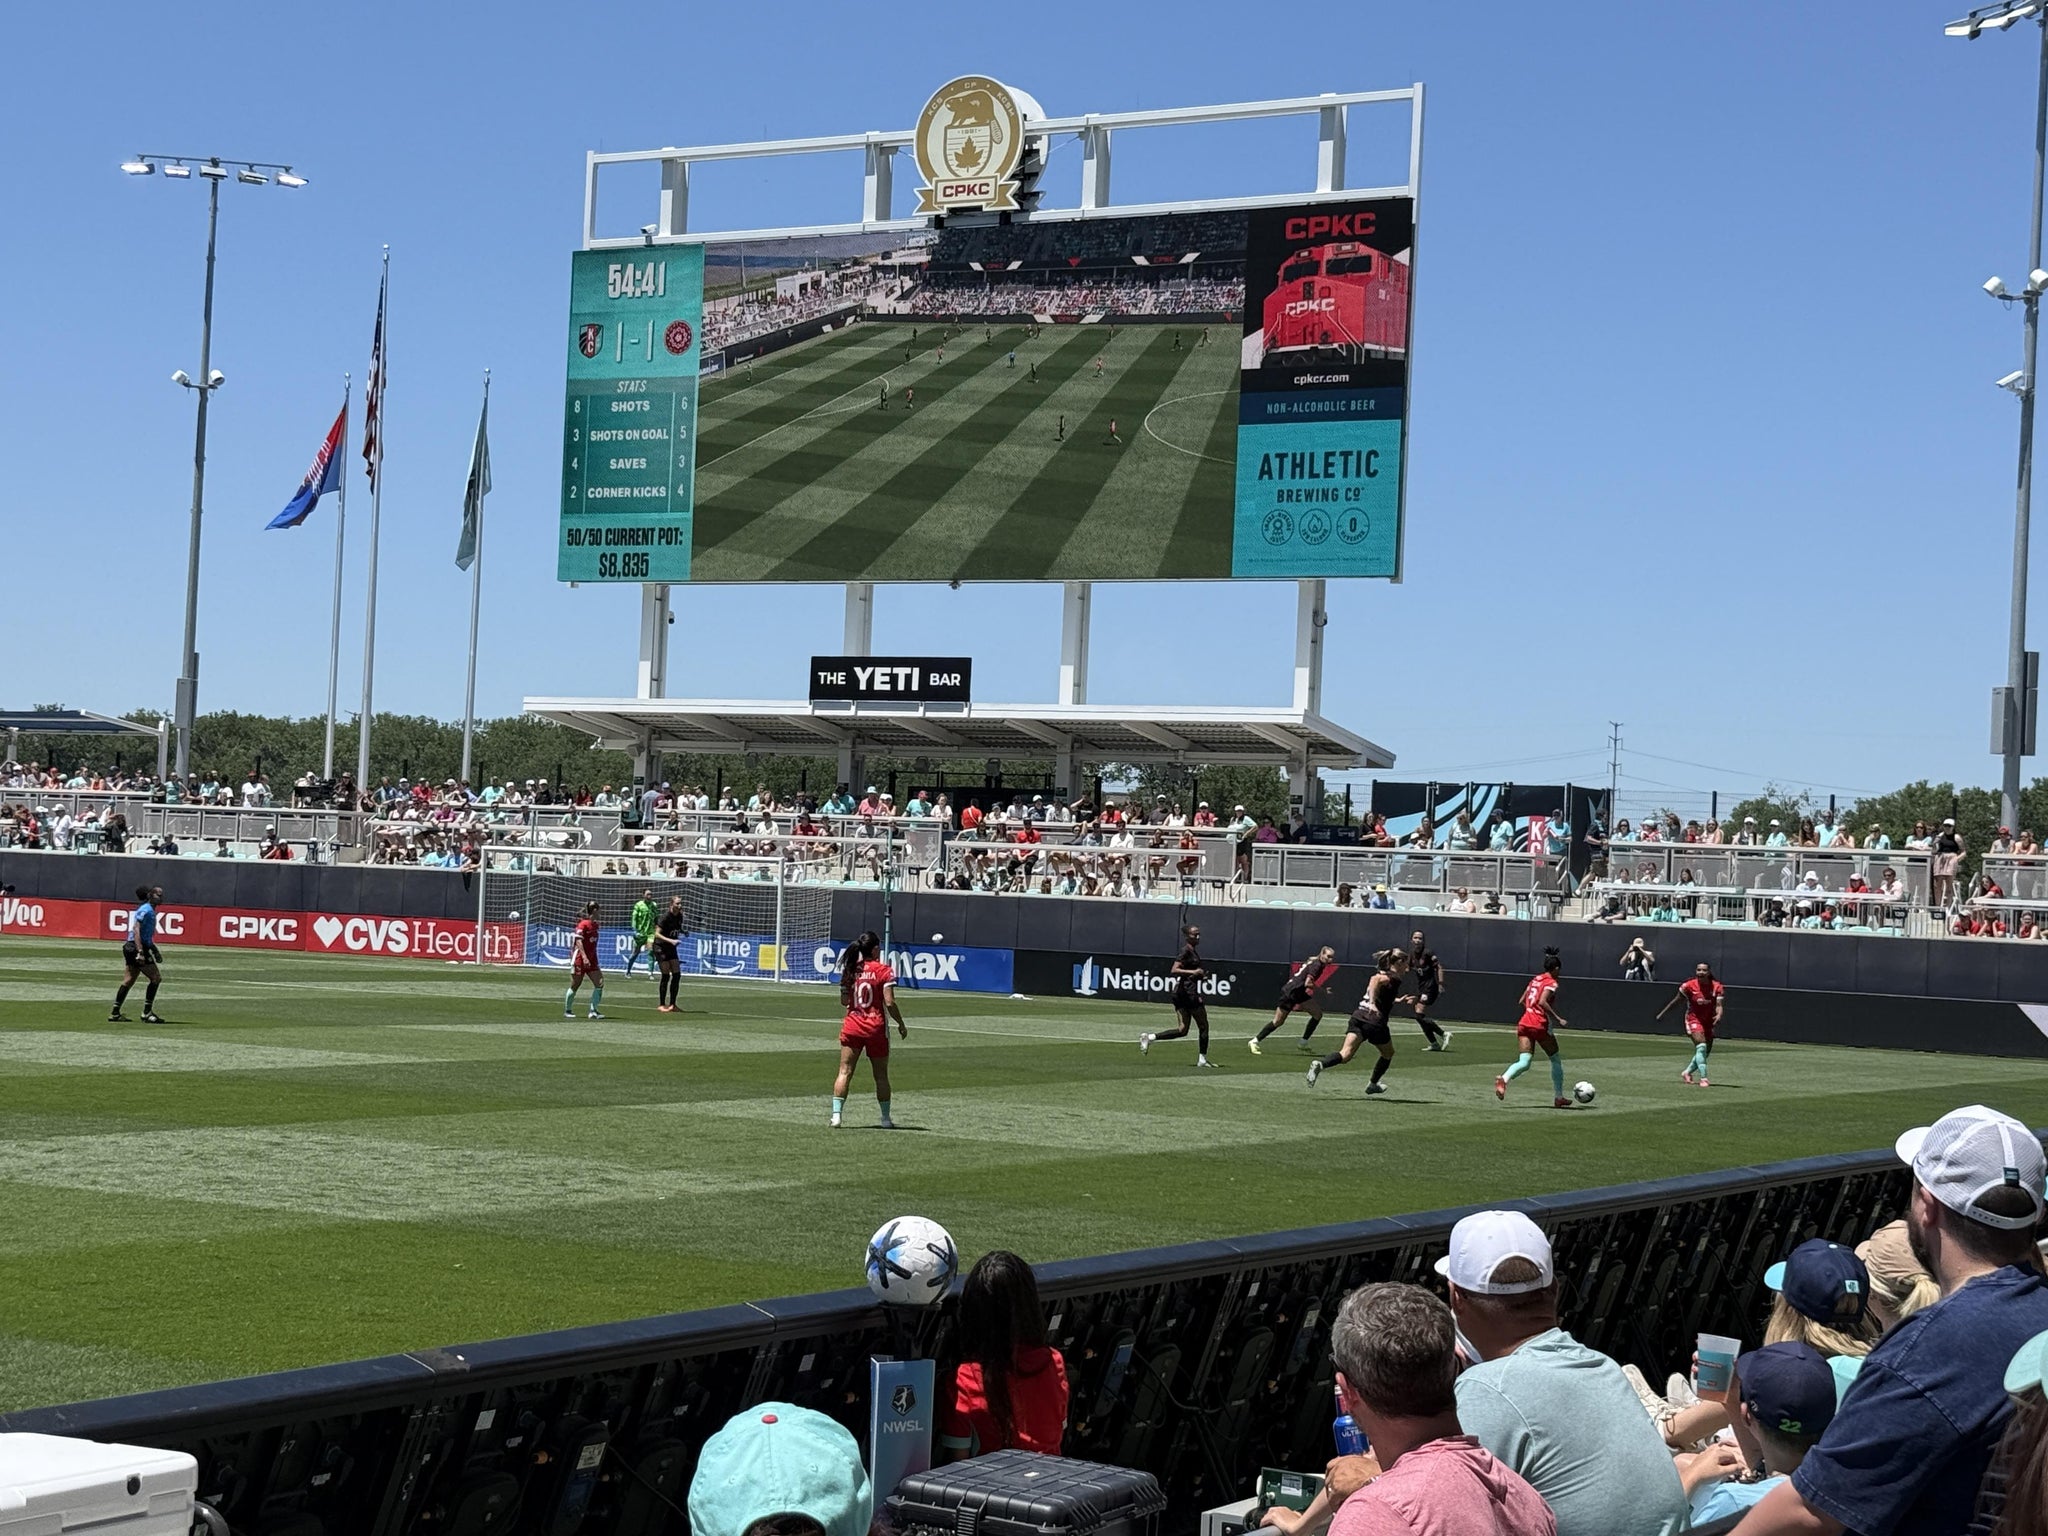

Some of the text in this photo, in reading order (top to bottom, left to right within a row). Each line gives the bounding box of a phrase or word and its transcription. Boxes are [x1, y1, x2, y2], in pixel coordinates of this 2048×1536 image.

[942, 182, 990, 198] CPKC
[1285, 212, 1376, 241] CPKC
[607, 261, 666, 299] 54:41
[1285, 298, 1335, 316] CPKC
[617, 380, 647, 393] STATS
[1293, 373, 1349, 386] cpkcr.com
[574, 397, 688, 413] 8 SHOTS 6
[1266, 399, 1376, 414] NON-ALCOHOLIC BEER
[573, 426, 687, 442] 3 SHOTS ON GOAL 5
[571, 455, 685, 471] 4 SAVES 3
[1258, 449, 1380, 481] ATHLETIC
[570, 483, 684, 499] 2 CORNER KICKS 4
[1276, 487, 1339, 504] BREWING
[567, 527, 684, 546] 50/50 CURRENT POT:
[599, 552, 650, 579] $8,835
[817, 666, 961, 691] THE YETI BAR
[1, 897, 44, 927] Vee
[219, 915, 298, 942] CPKC
[344, 917, 513, 958] CVS Heath
[537, 926, 576, 950] prim
[697, 935, 751, 958] prime
[1102, 967, 1232, 996] Nationide
[853, 981, 874, 1009] 10
[883, 1420, 923, 1434] NWSL
[1779, 1418, 1802, 1433] 22
